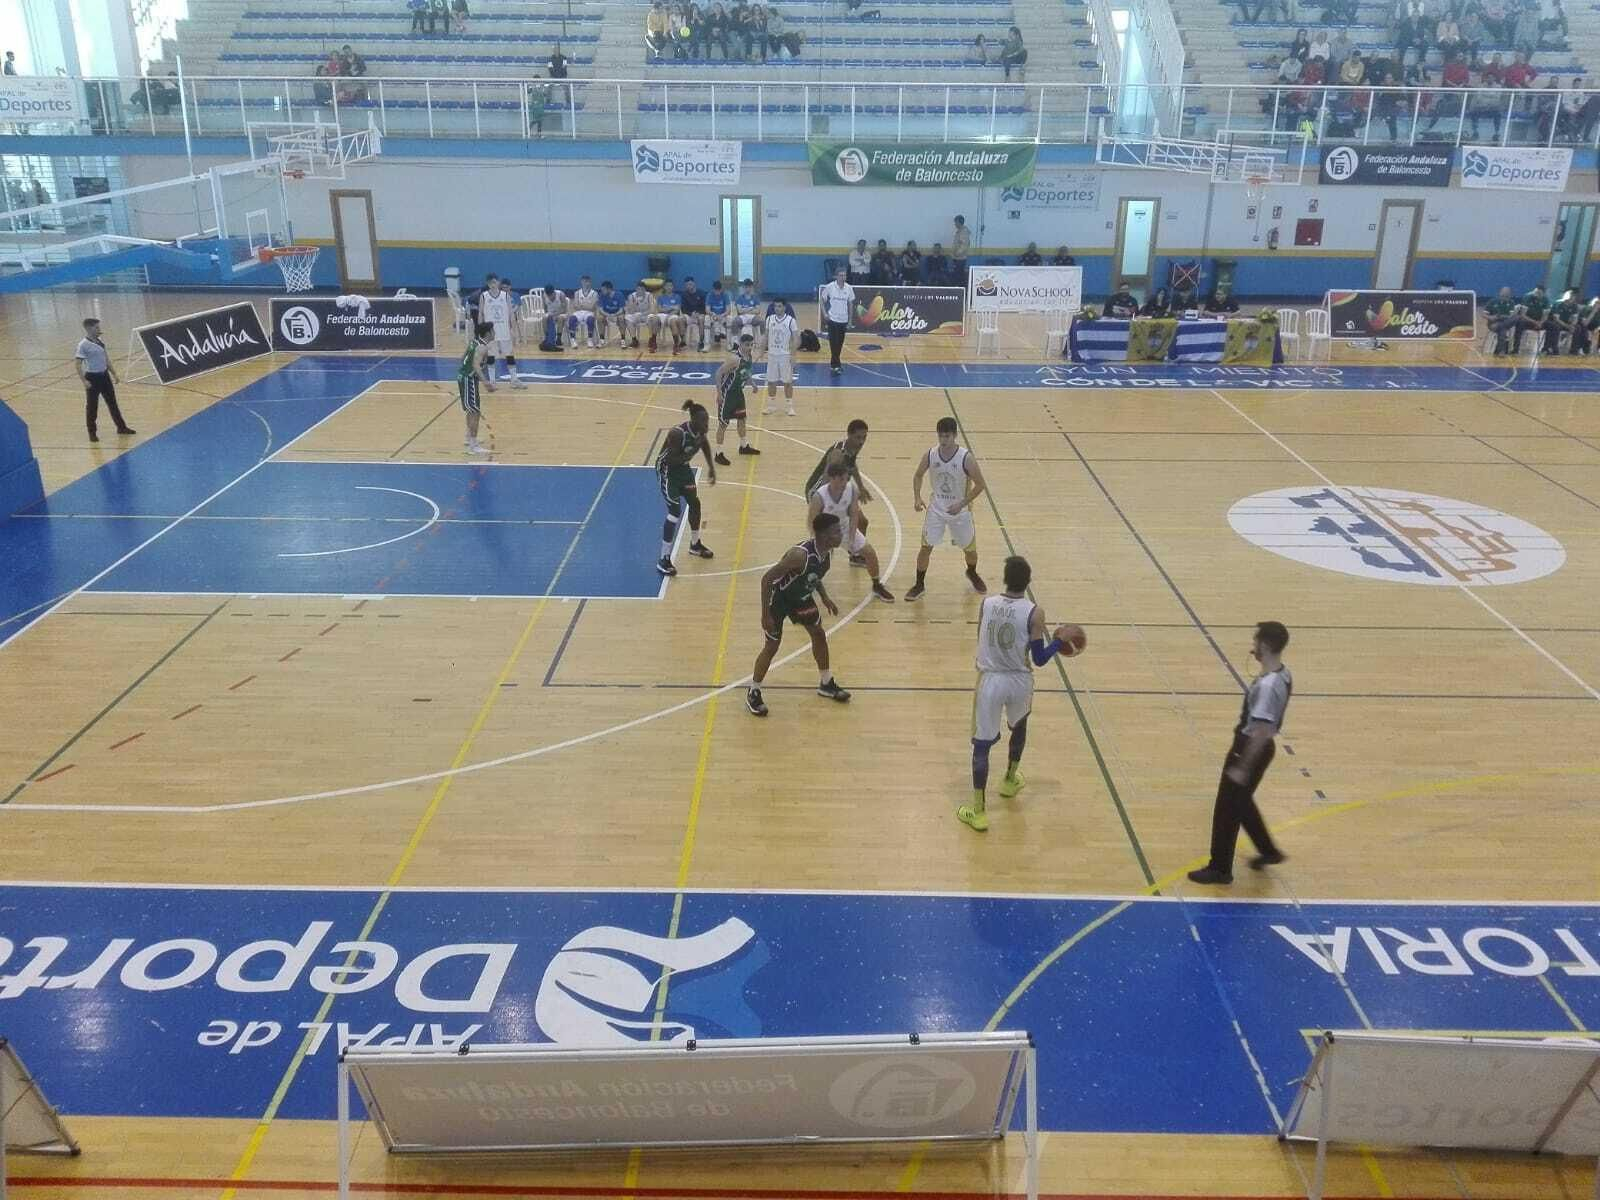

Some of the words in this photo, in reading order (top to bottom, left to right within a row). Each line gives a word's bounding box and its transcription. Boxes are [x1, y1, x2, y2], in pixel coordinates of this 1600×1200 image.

[0, 98, 72, 115] Deportes
[873, 150, 942, 165] Federación
[945, 150, 1009, 165] Andaluza
[1364, 153, 1407, 164] Federación
[1408, 155, 1448, 166] Andaluza
[663, 159, 735, 176] Deportes
[895, 167, 912, 182] de
[914, 167, 984, 183] Baloncesto
[1377, 165, 1387, 174] de
[1388, 165, 1431, 176] Baloncesto
[1489, 164, 1561, 181] Deportes
[1026, 188, 1094, 204] Deportes
[380, 314, 426, 325] Andaluza
[890, 315, 928, 330] cesto
[344, 326, 356, 336] de
[358, 326, 410, 337] Baloncesto
[1401, 320, 1439, 336] cesto
[155, 317, 259, 369] Andalucía
[986, 620, 1017, 650] 10
[0, 920, 518, 1013] Deport
[197, 1019, 282, 1054] de
